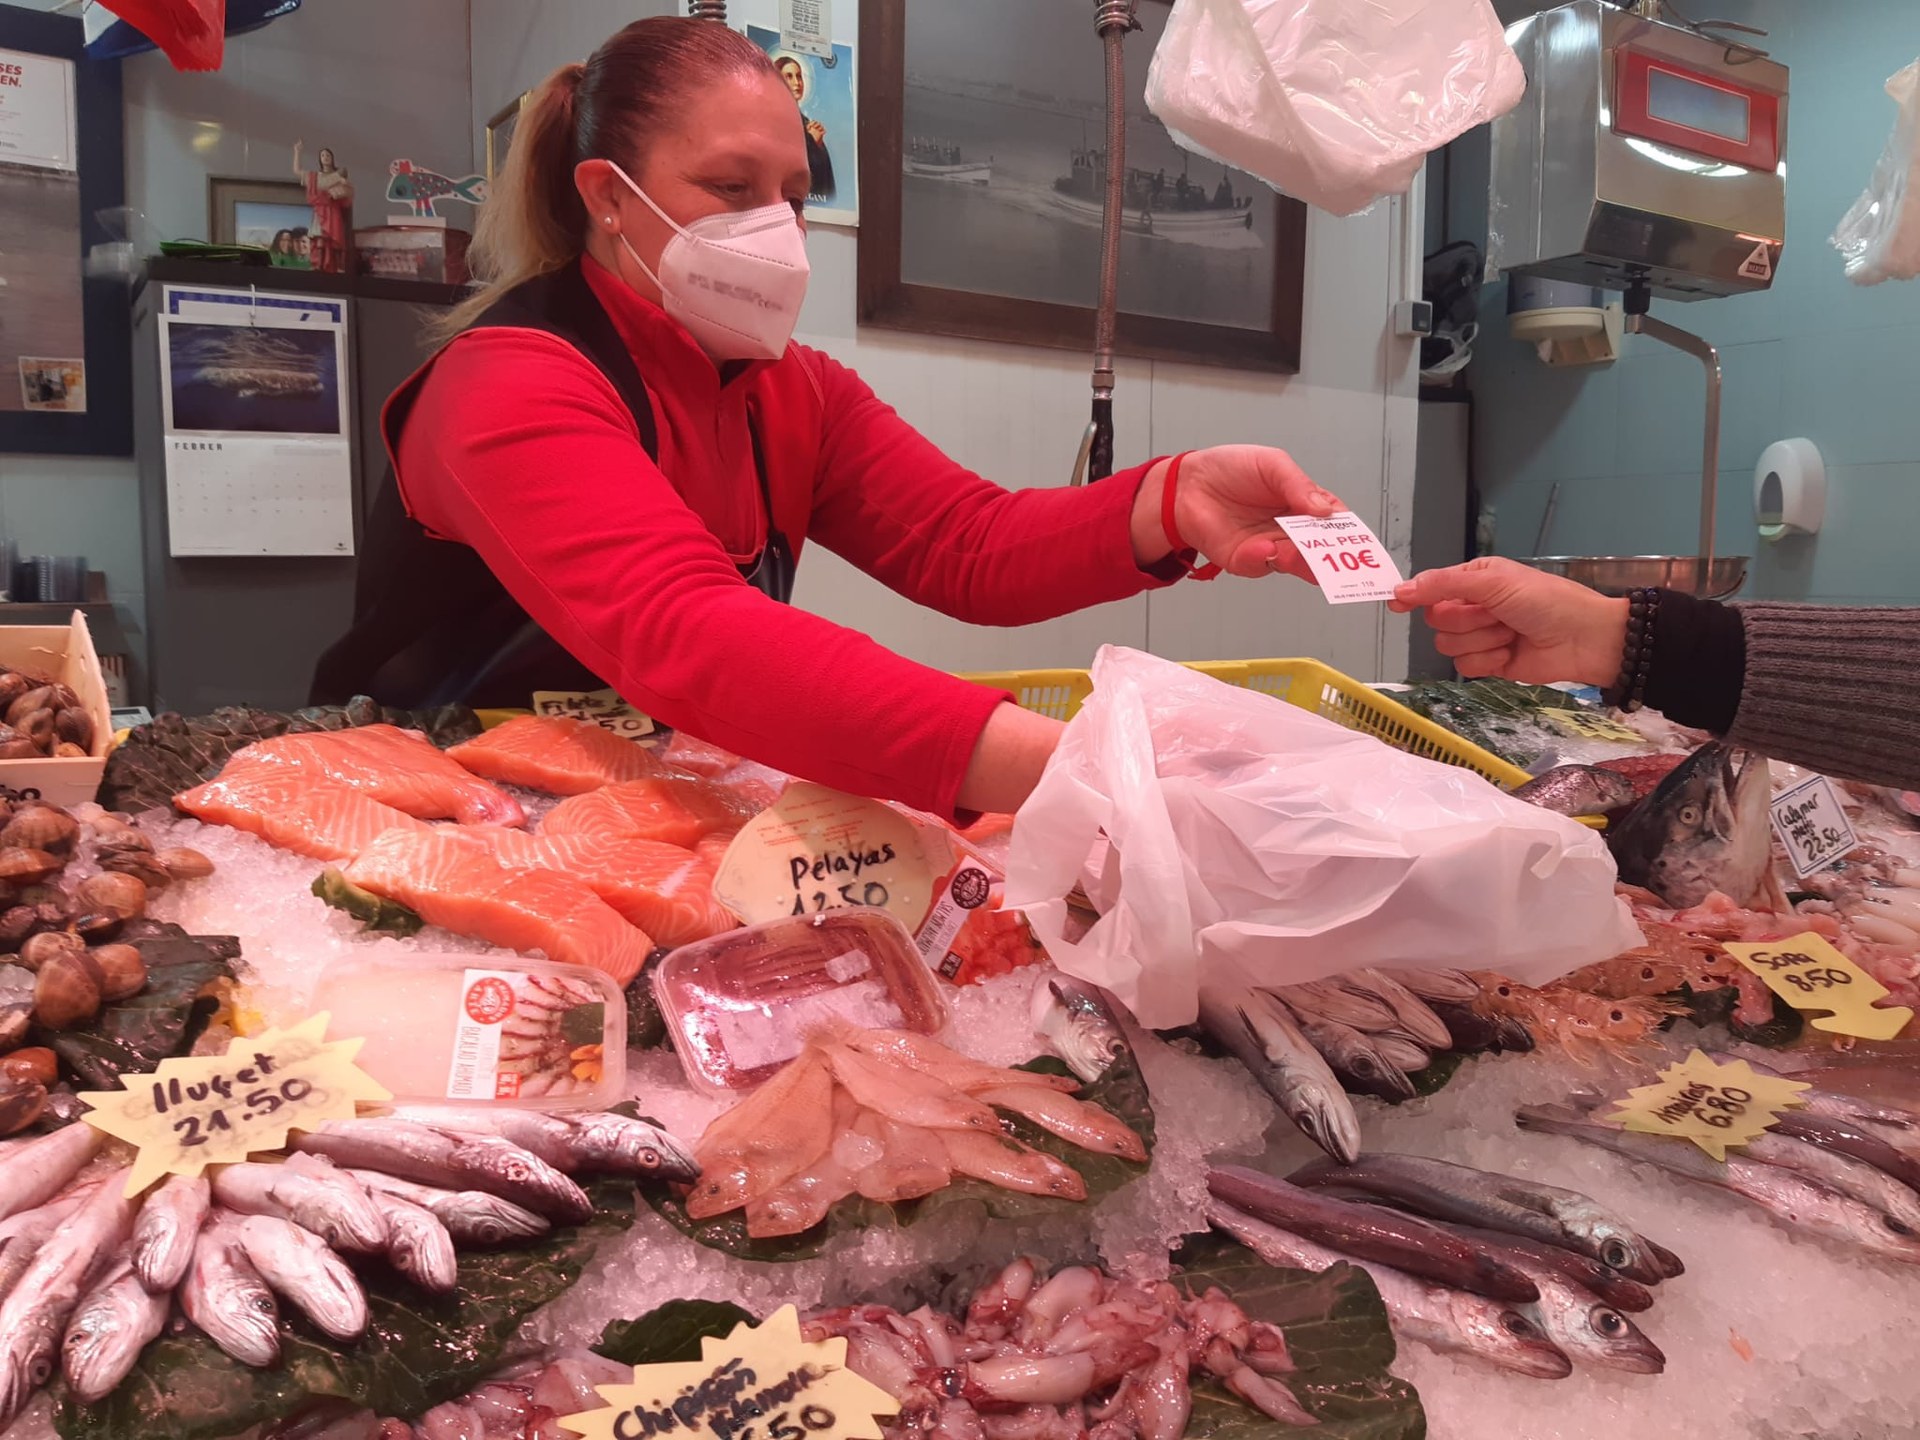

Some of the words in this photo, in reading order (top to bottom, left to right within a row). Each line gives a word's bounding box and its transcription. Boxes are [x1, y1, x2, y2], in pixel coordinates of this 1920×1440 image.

[1300, 538, 1335, 549] VAL
[1336, 534, 1373, 546] PER
[1322, 549, 1381, 573] 10€
